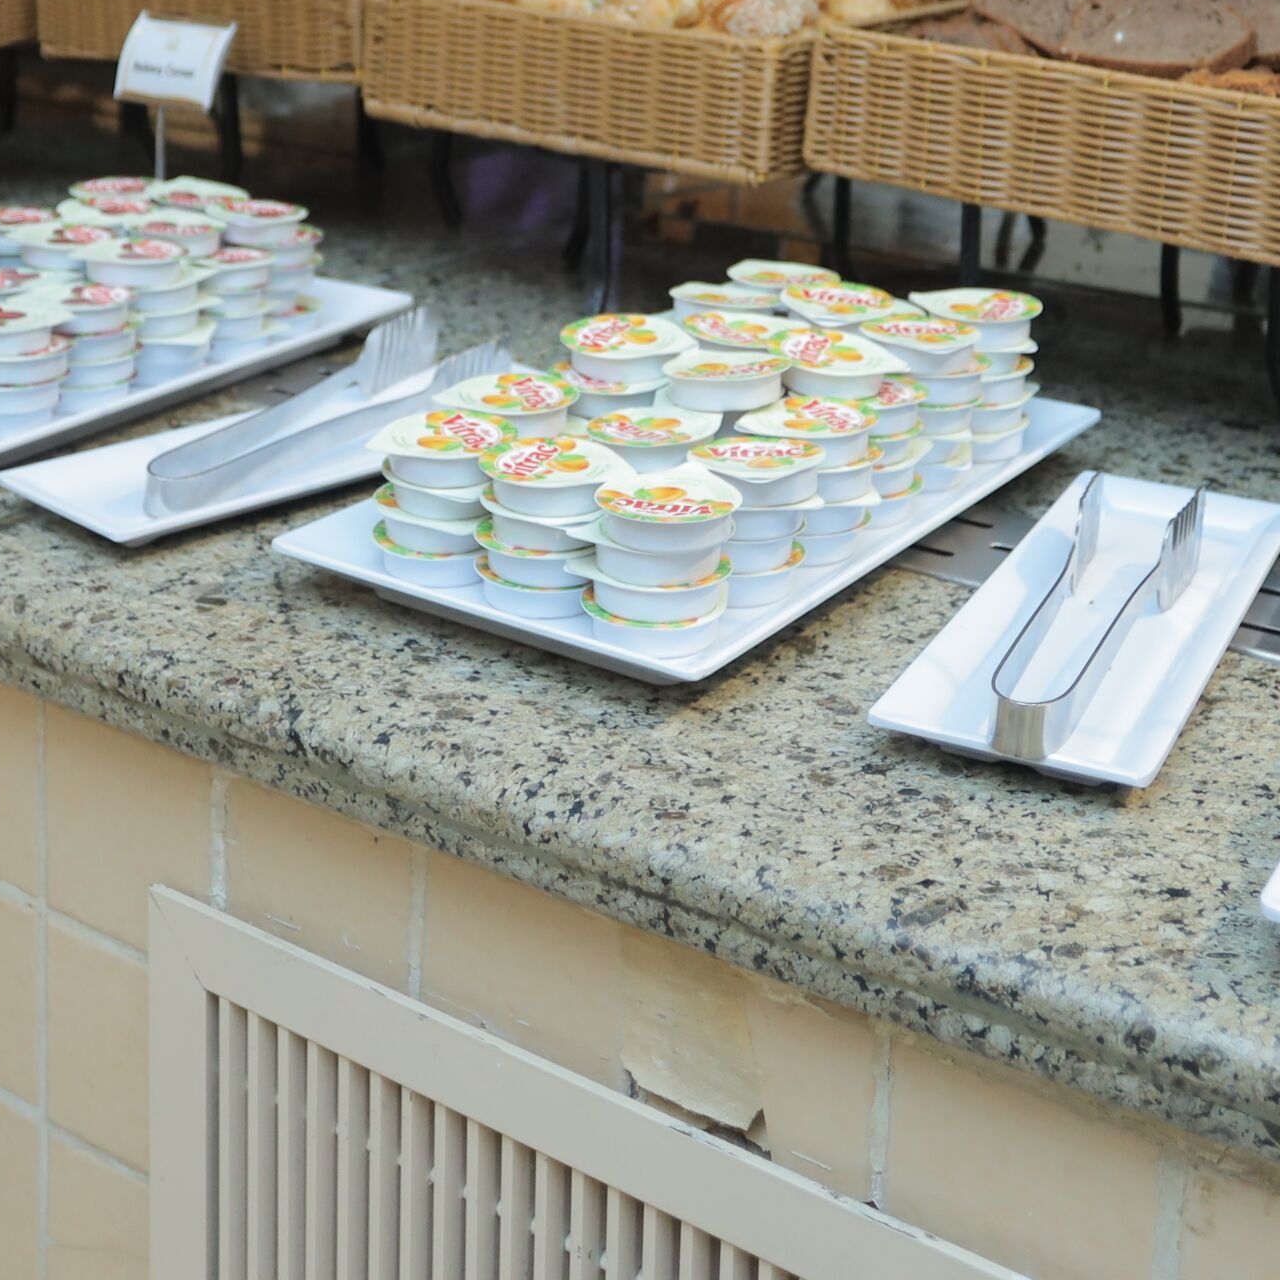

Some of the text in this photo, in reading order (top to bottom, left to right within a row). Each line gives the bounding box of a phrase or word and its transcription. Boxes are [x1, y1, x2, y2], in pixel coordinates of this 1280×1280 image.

[496, 443, 560, 477] Vitrac
[707, 445, 806, 459] Vitrac
[613, 498, 713, 516] Vitrac
